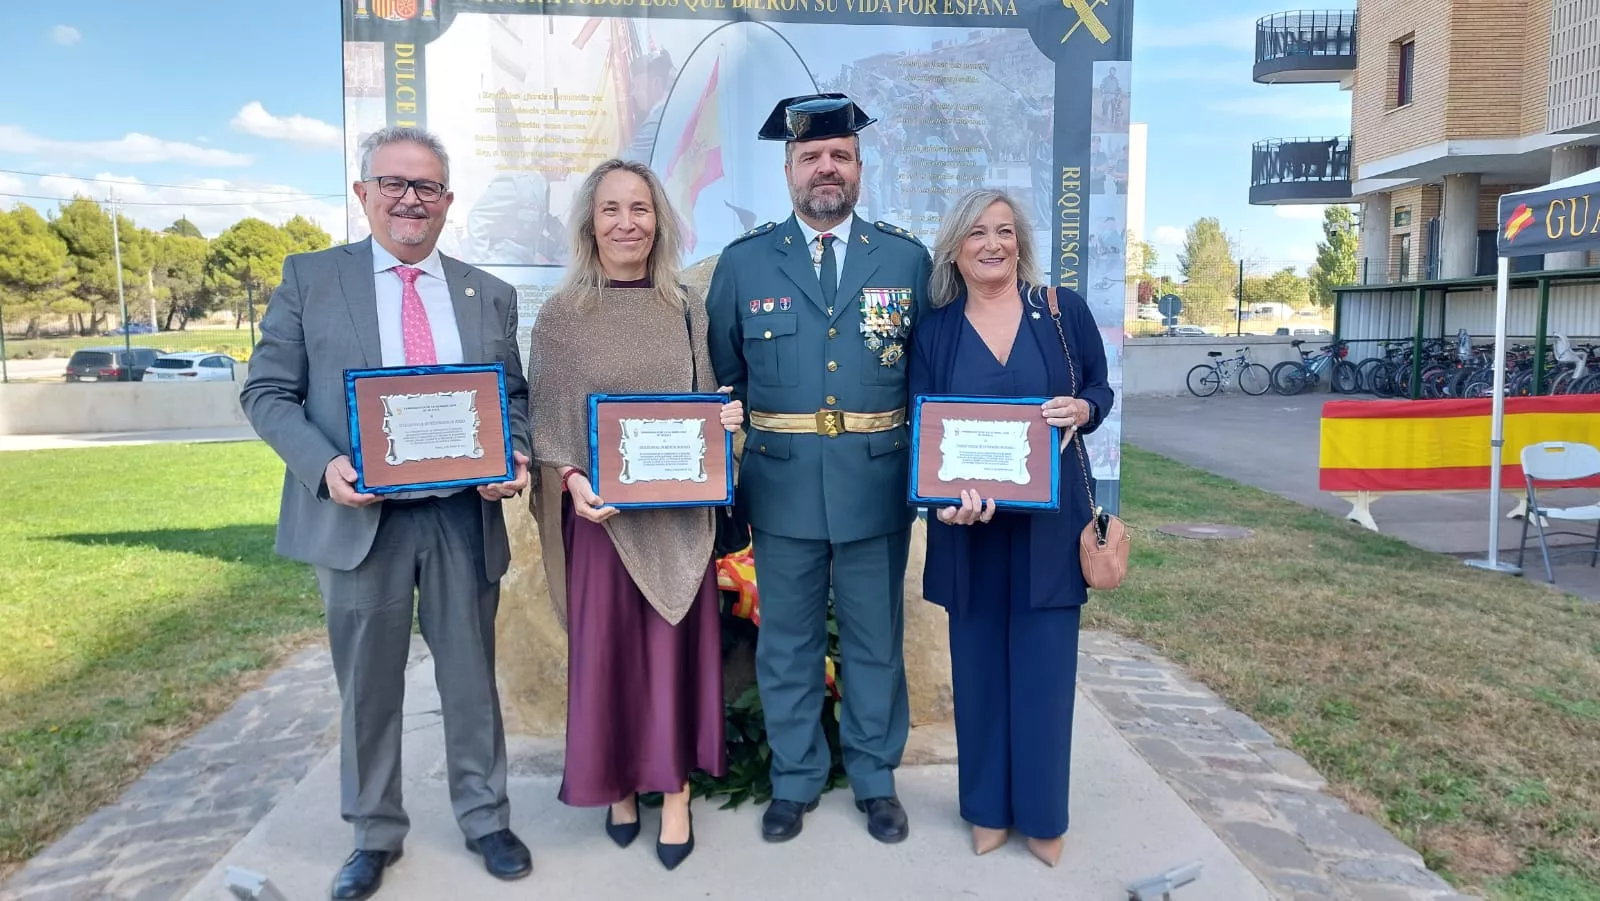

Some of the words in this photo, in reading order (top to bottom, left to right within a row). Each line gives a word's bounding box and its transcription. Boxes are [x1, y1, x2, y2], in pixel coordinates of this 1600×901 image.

[845, 0, 892, 13] VIDA
[896, 0, 938, 15] POR
[395, 43, 416, 114] DULCE
[1058, 166, 1081, 292] REQUIESCAT
